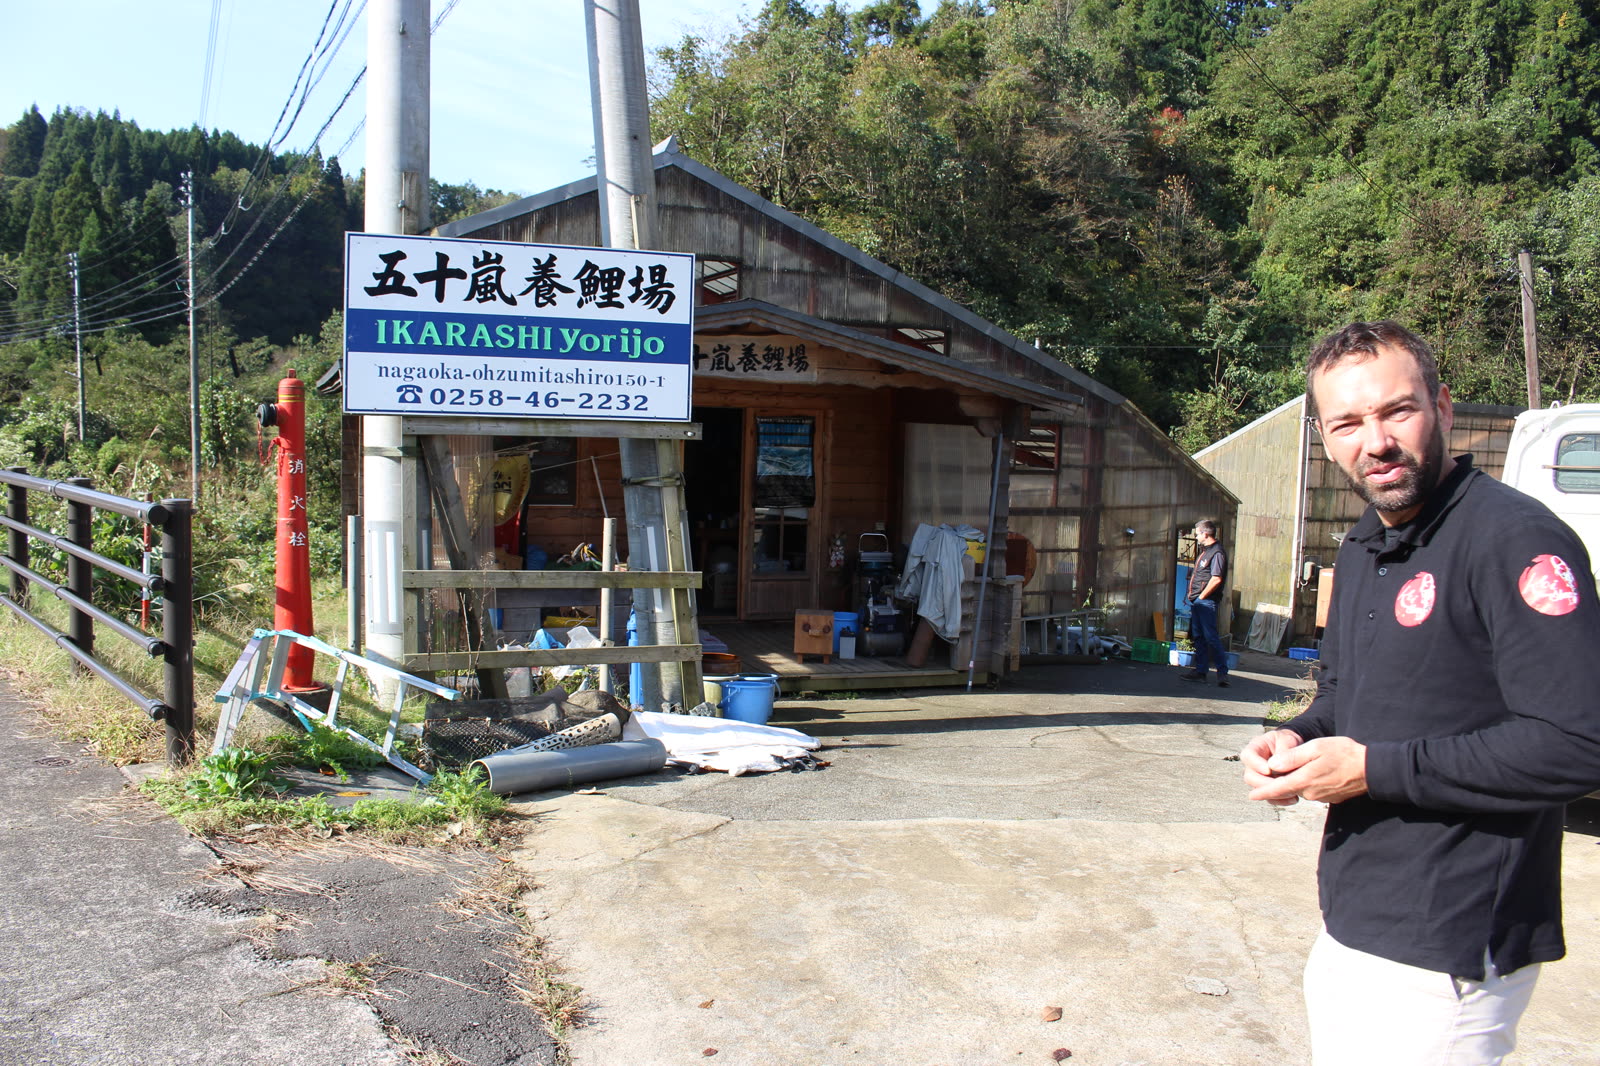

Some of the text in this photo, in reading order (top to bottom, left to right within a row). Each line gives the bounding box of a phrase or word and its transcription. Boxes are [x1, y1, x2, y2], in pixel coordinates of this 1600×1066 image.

[364, 250, 677, 315] 五十嵐養鯉場
[376, 319, 665, 359] IKARASHI yorijo
[430, 388, 648, 411] 0258-46-2232
[288, 459, 306, 547] 消火栓
